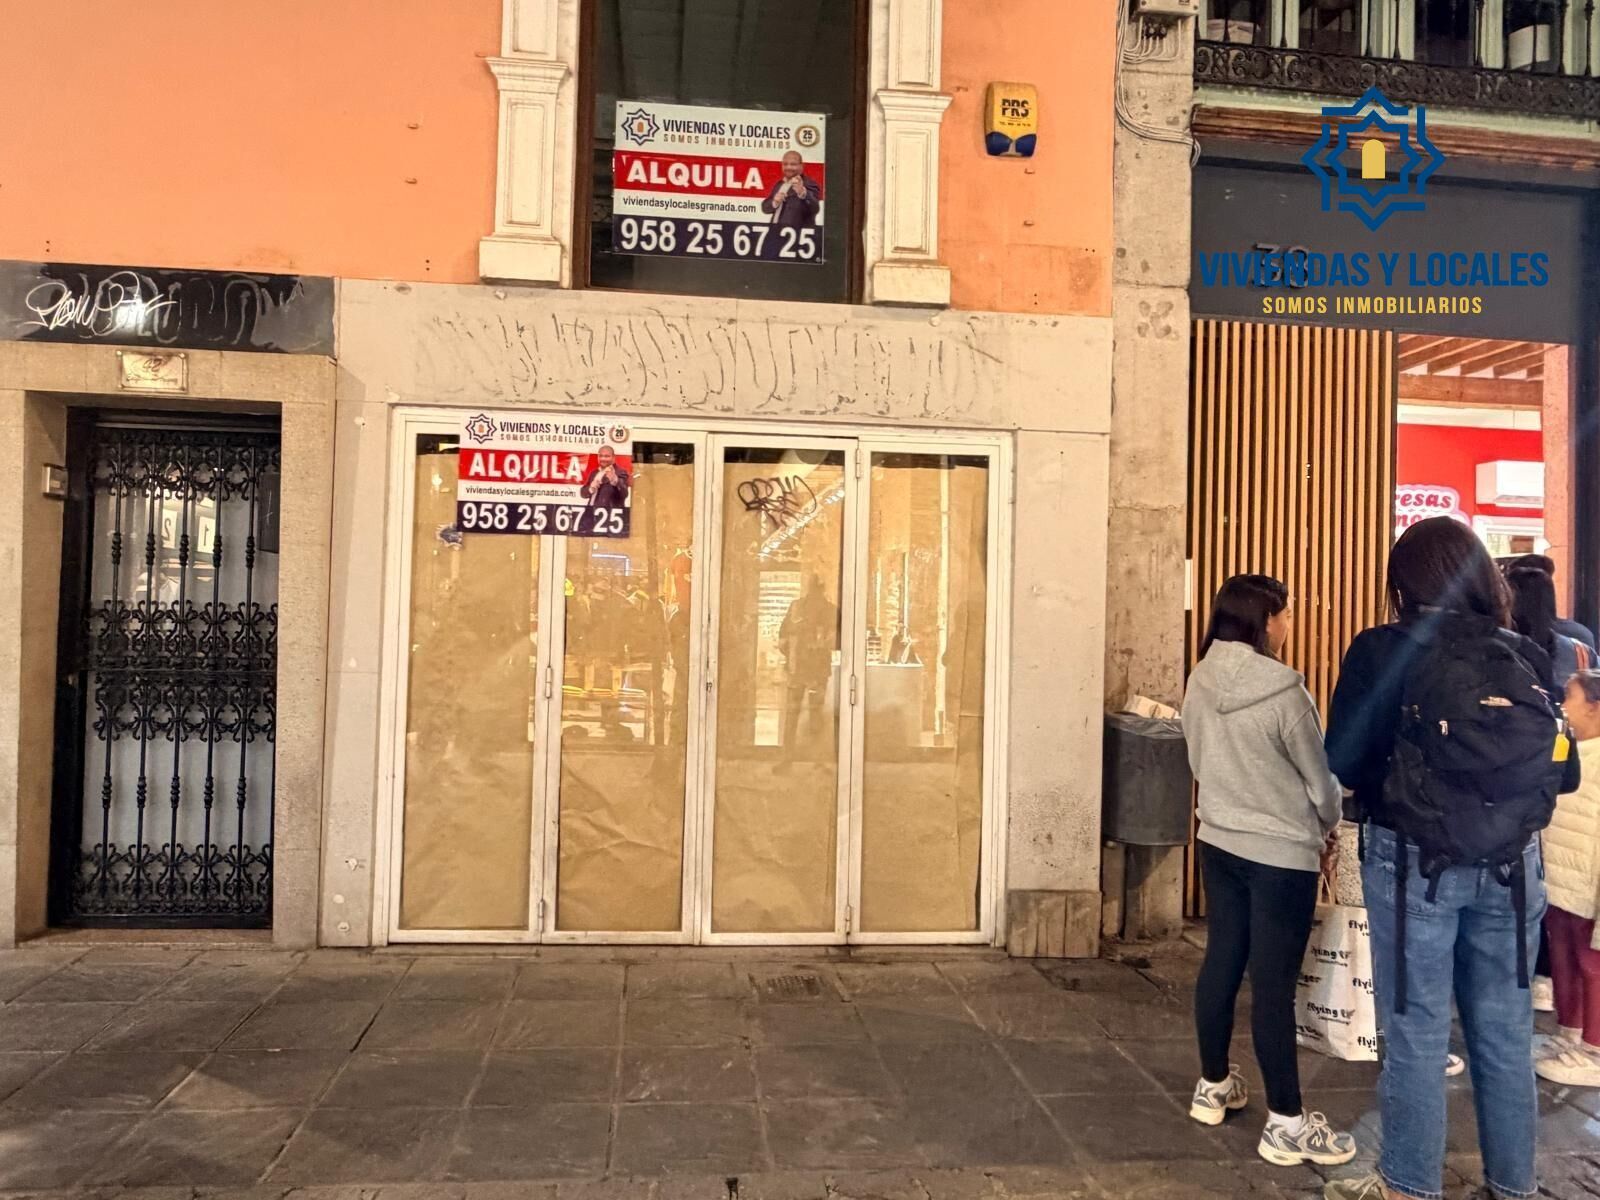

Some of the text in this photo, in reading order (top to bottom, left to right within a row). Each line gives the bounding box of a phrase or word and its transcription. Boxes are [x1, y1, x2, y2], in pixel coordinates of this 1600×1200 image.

[1001, 99, 1029, 117] PRS
[663, 119, 791, 140] VIVIENDAS Y LOCALES
[663, 134, 791, 150] SOMOS INMOBILIARIOS
[627, 160, 765, 190] ALQUILA
[623, 196, 757, 214] viviendasylocalesgranada.com
[620, 218, 816, 260] 958 25 67 25
[500, 421, 606, 437] VIVIENDAS Y LOCALES
[469, 452, 583, 482] ALQUILA
[466, 487, 577, 498] viviendasylocalesgranada.com
[462, 502, 624, 534] 958 25 67 25
[1348, 920, 1369, 932] flyi
[1352, 977, 1372, 990] flyi
[1357, 1036, 1376, 1049] flyi
